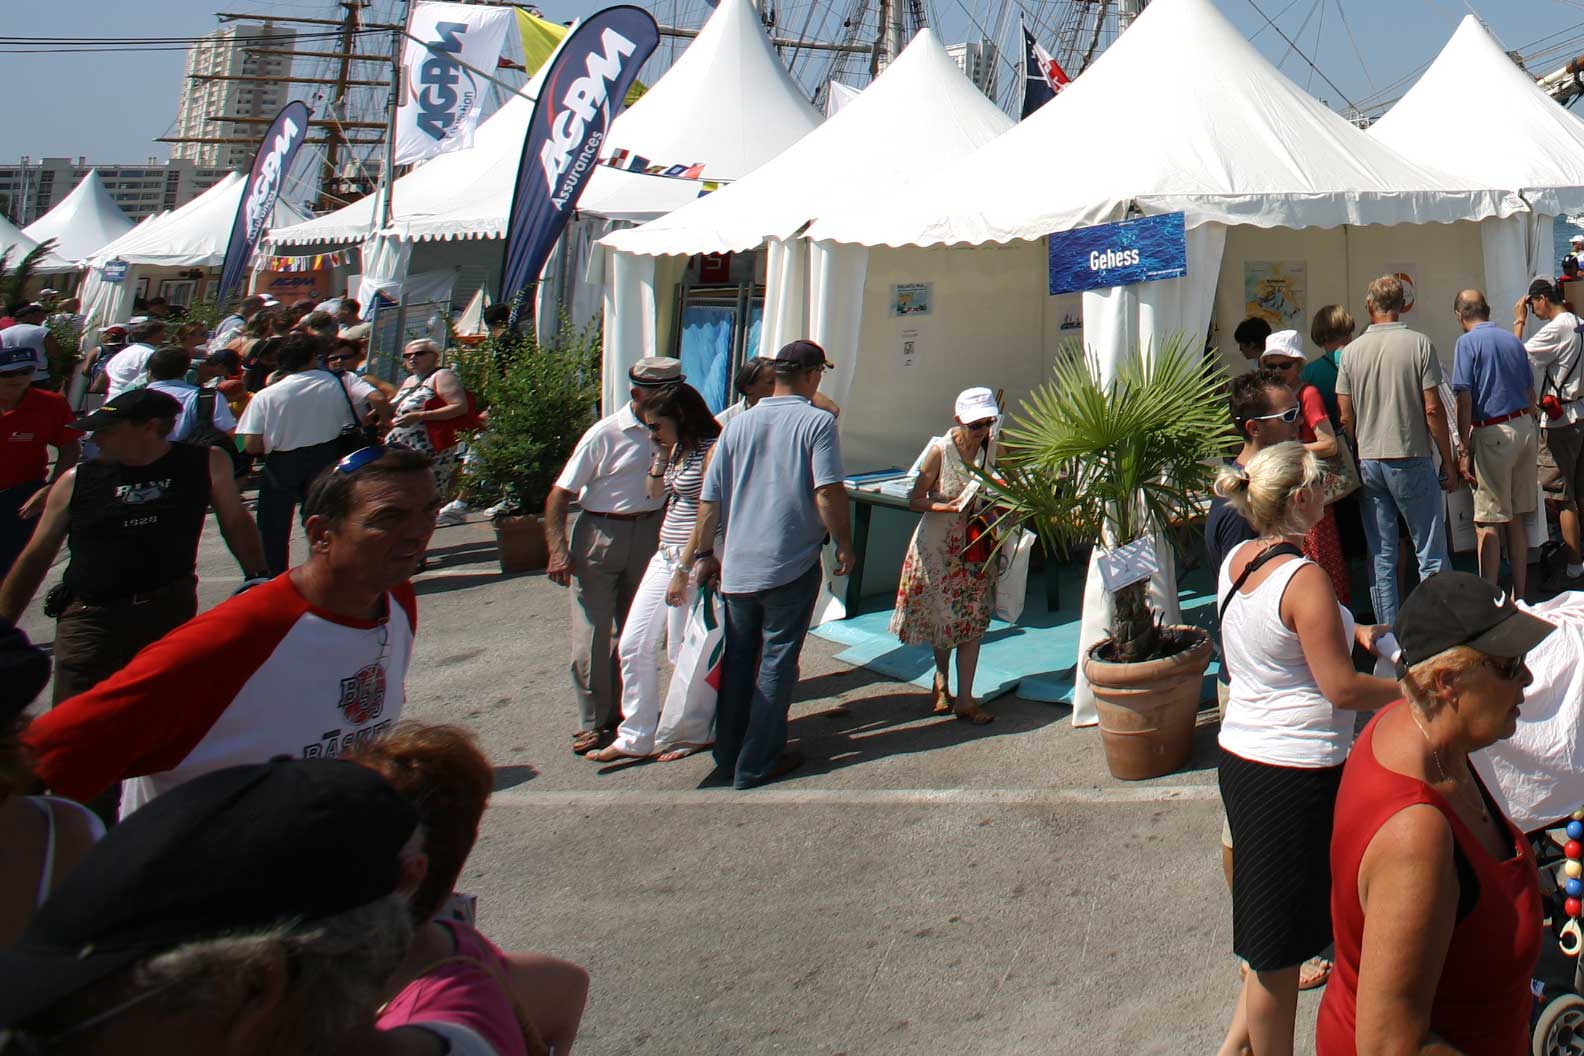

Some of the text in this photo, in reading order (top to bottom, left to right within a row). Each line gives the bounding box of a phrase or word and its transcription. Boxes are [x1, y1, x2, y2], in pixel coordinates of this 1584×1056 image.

[417, 21, 469, 141] AGPM
[540, 27, 637, 198] AGPM
[246, 117, 299, 237] AGPM
[552, 130, 603, 212] Assurances
[1090, 248, 1140, 271] Gehess
